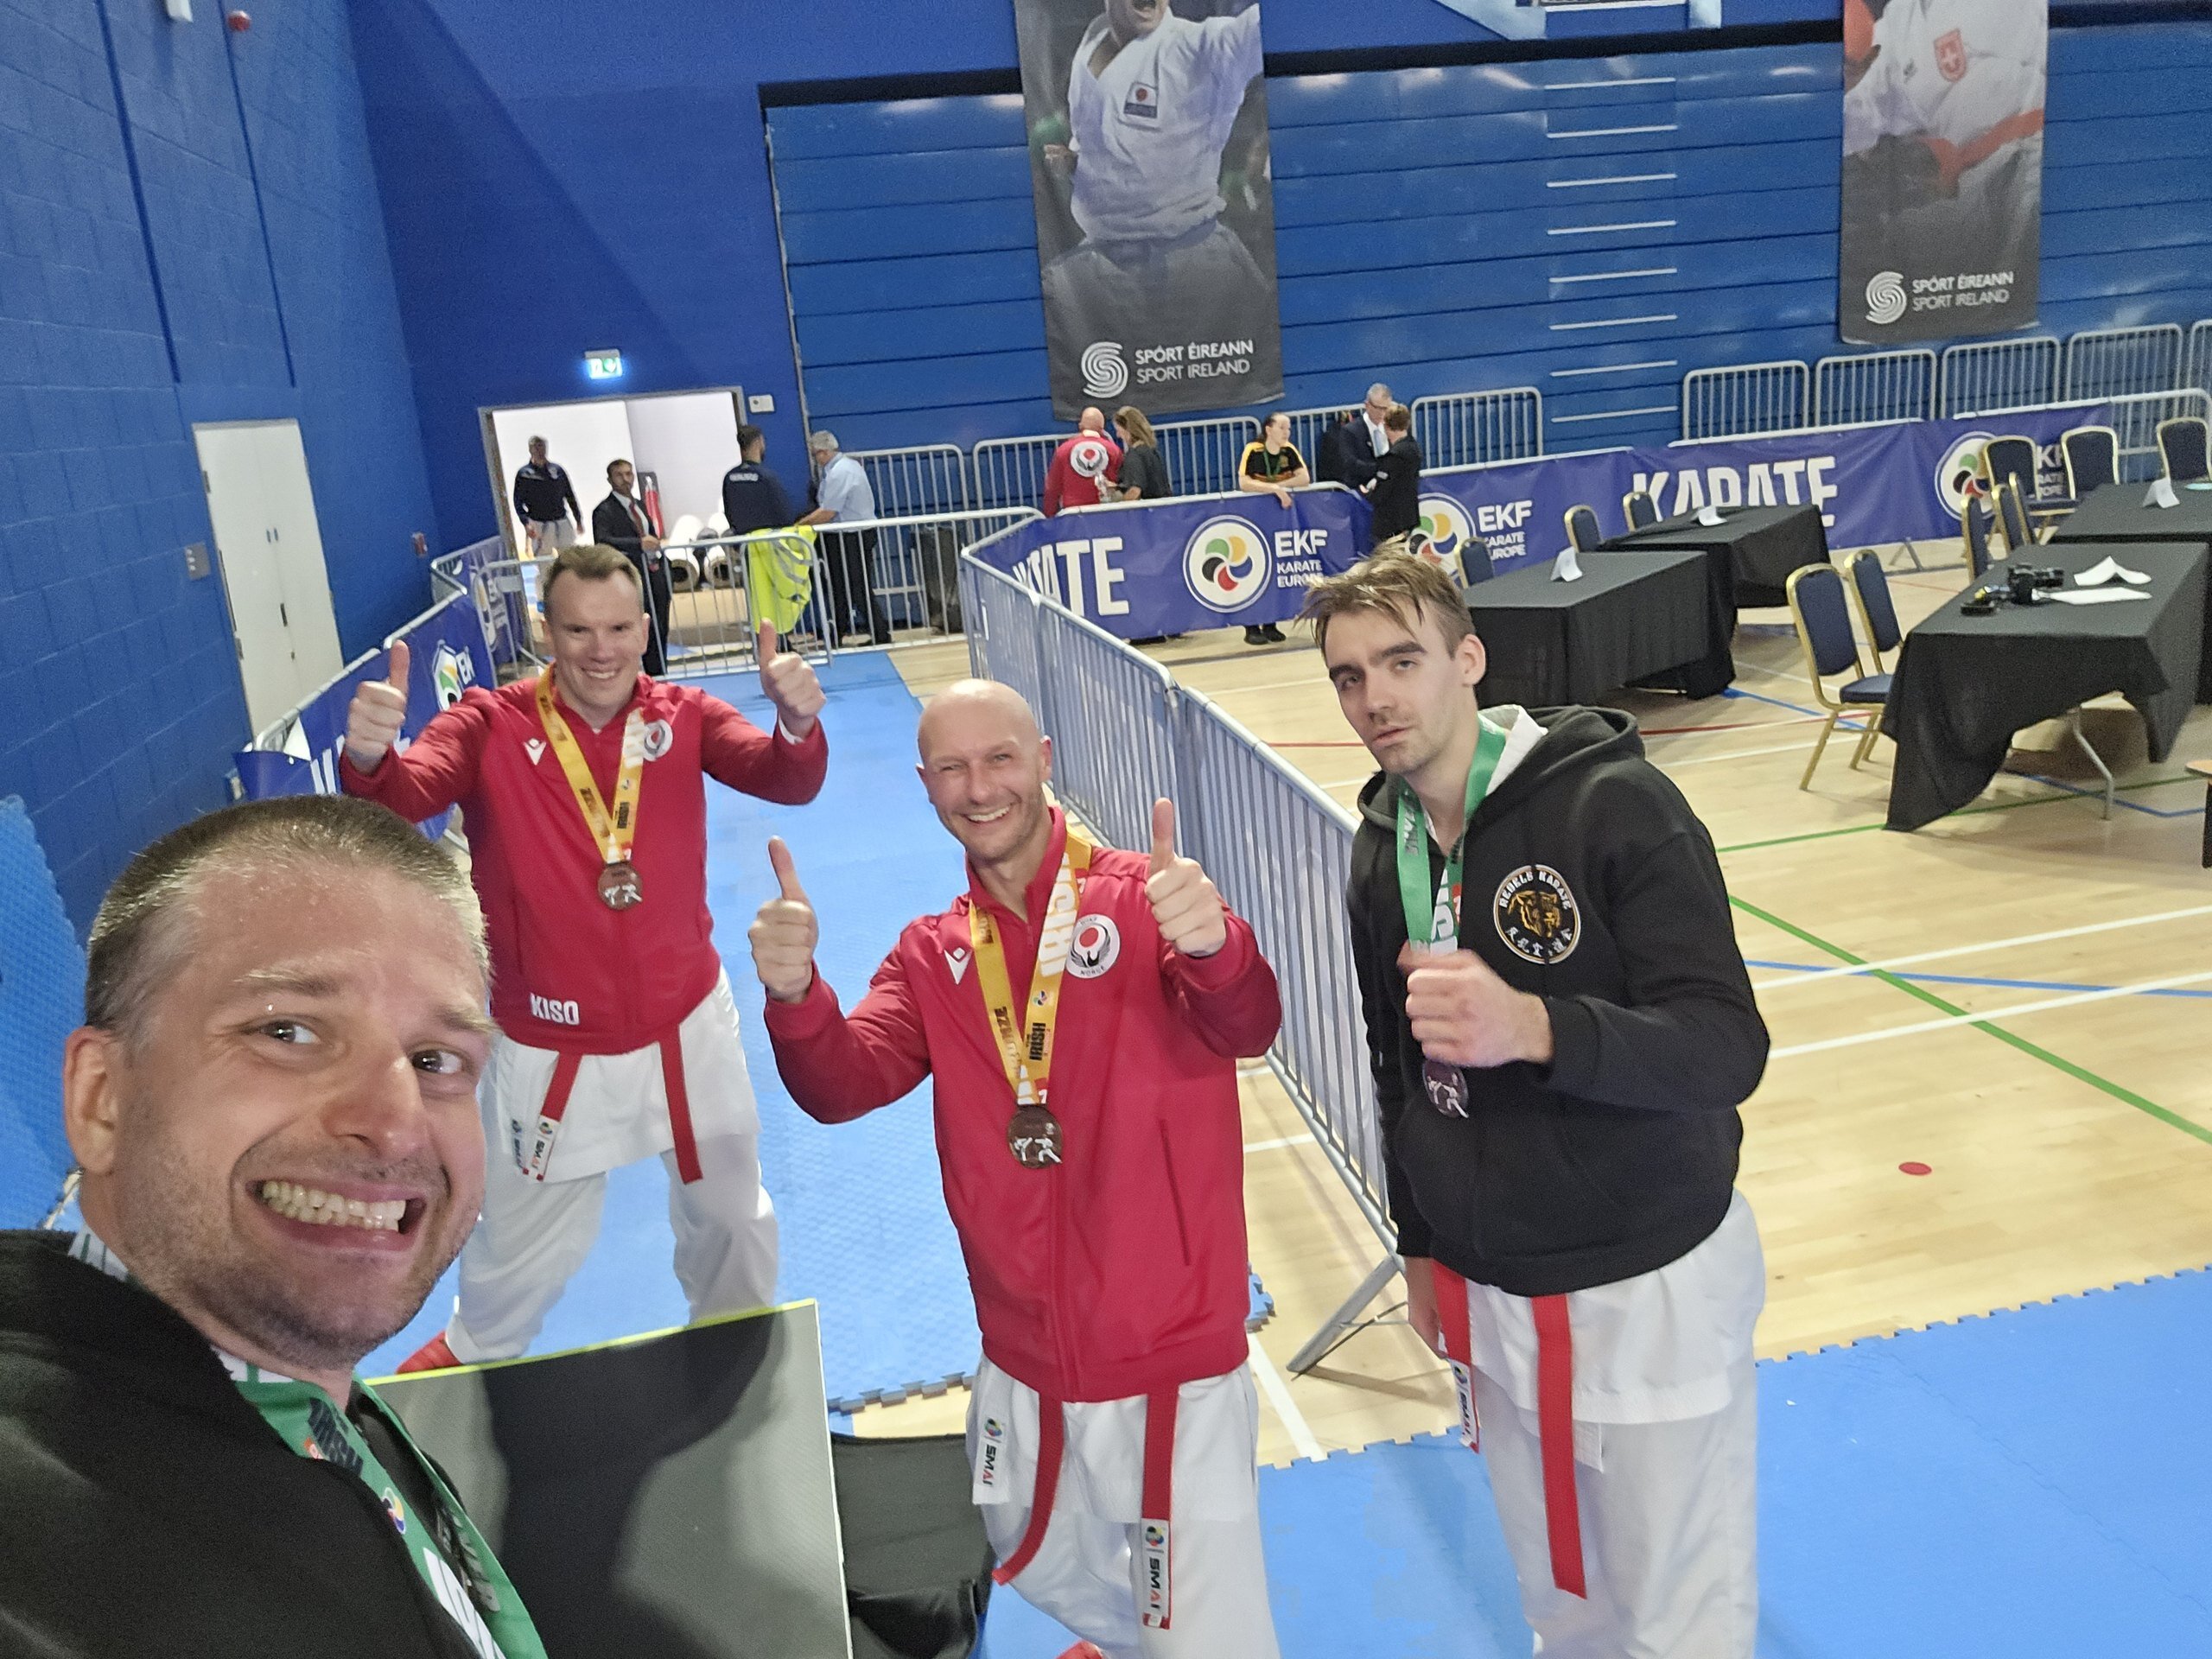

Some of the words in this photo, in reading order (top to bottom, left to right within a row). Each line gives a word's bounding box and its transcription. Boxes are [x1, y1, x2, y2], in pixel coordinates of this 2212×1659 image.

[1912, 294, 1952, 311] SPORT
[1955, 289, 2010, 306] IRELAND
[1135, 345, 1184, 365] SPÓRT
[1136, 365, 1184, 384] SPORT
[1187, 359, 1250, 378] IRELAND
[1478, 500, 1533, 532] EKF
[1274, 529, 1327, 558] EKF
[1484, 531, 1526, 548] ARATE
[1276, 559, 1322, 574] KARATE
[1539, 871, 1572, 910] KARATE
[531, 992, 579, 1026] KISO
[1029, 1022, 1046, 1061] IRISH
[982, 1444, 997, 1487] SMAI
[1148, 1557, 1161, 1609] SMAI
